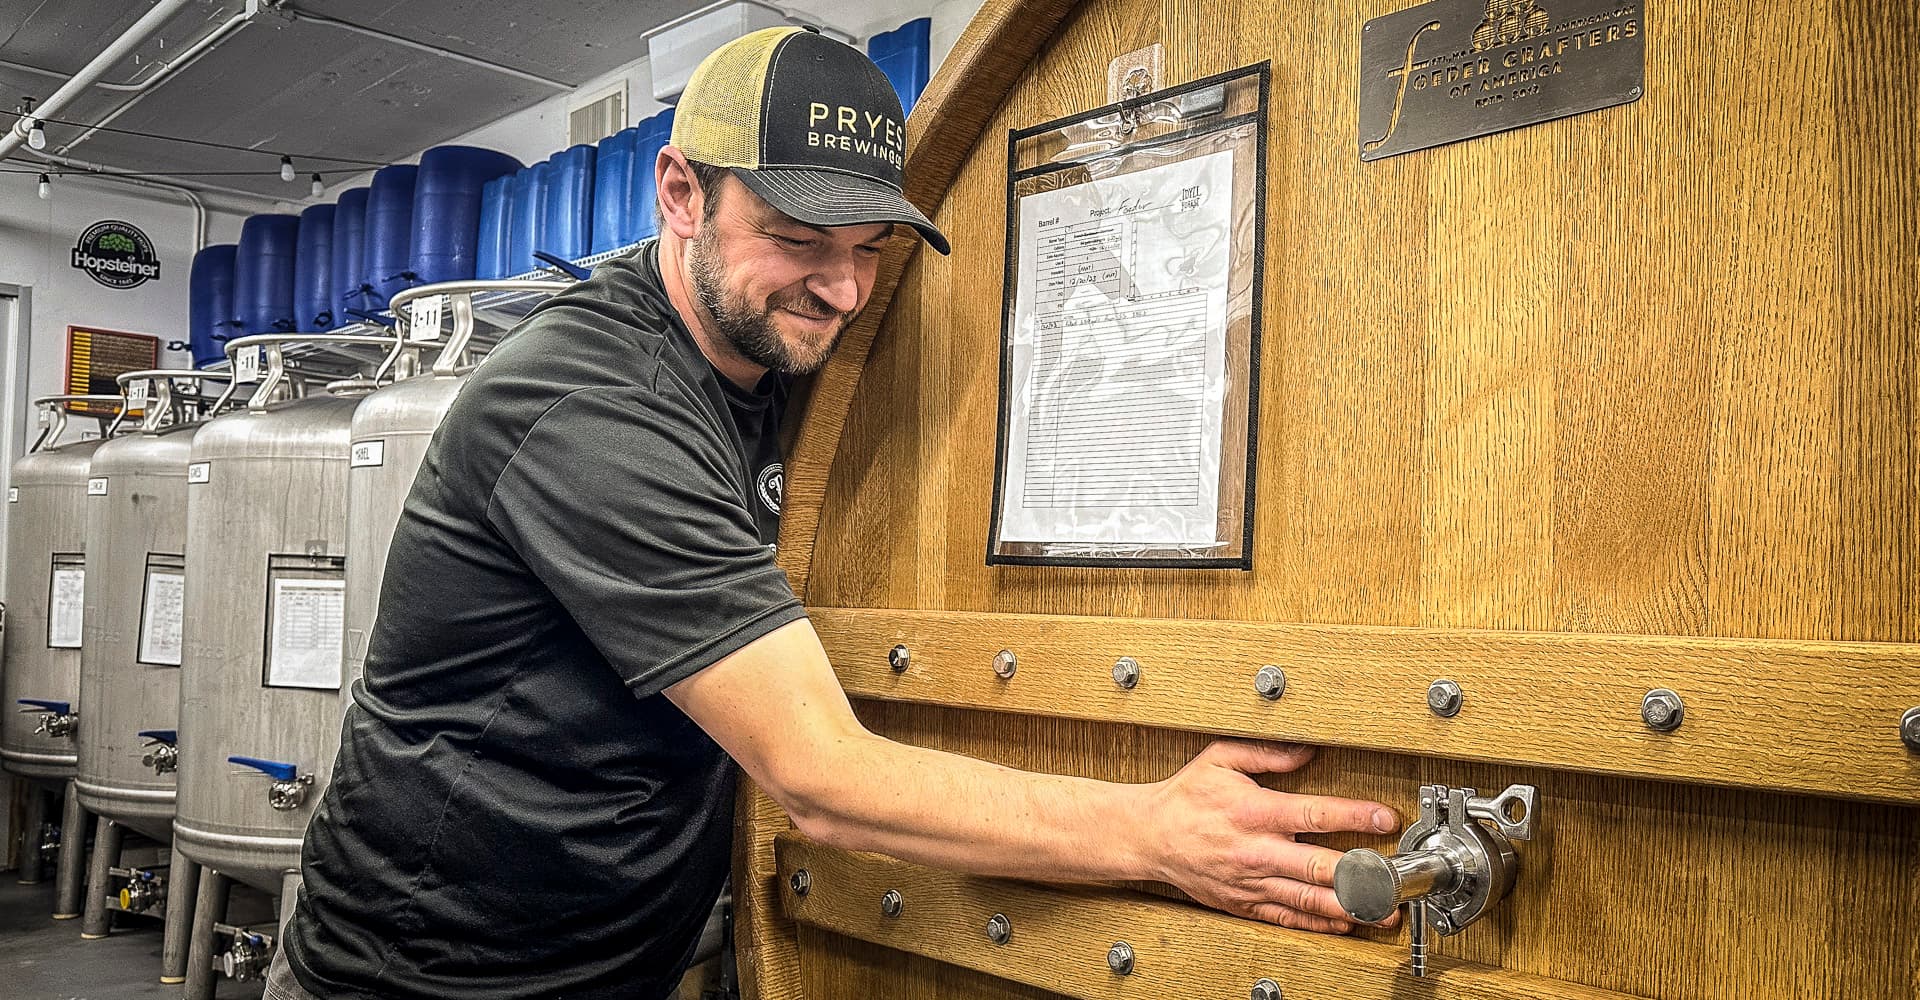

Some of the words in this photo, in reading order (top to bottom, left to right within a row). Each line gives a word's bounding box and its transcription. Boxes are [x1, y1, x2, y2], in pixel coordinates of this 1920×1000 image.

[1503, 19, 1638, 69] CRAFTERS
[1450, 82, 1471, 98] OF
[1480, 62, 1562, 93] AMERICA
[809, 102, 903, 152] PRYES
[808, 132, 895, 165] BREWING
[1038, 218, 1054, 228] Barrel
[75, 251, 158, 276] Hopsteiner
